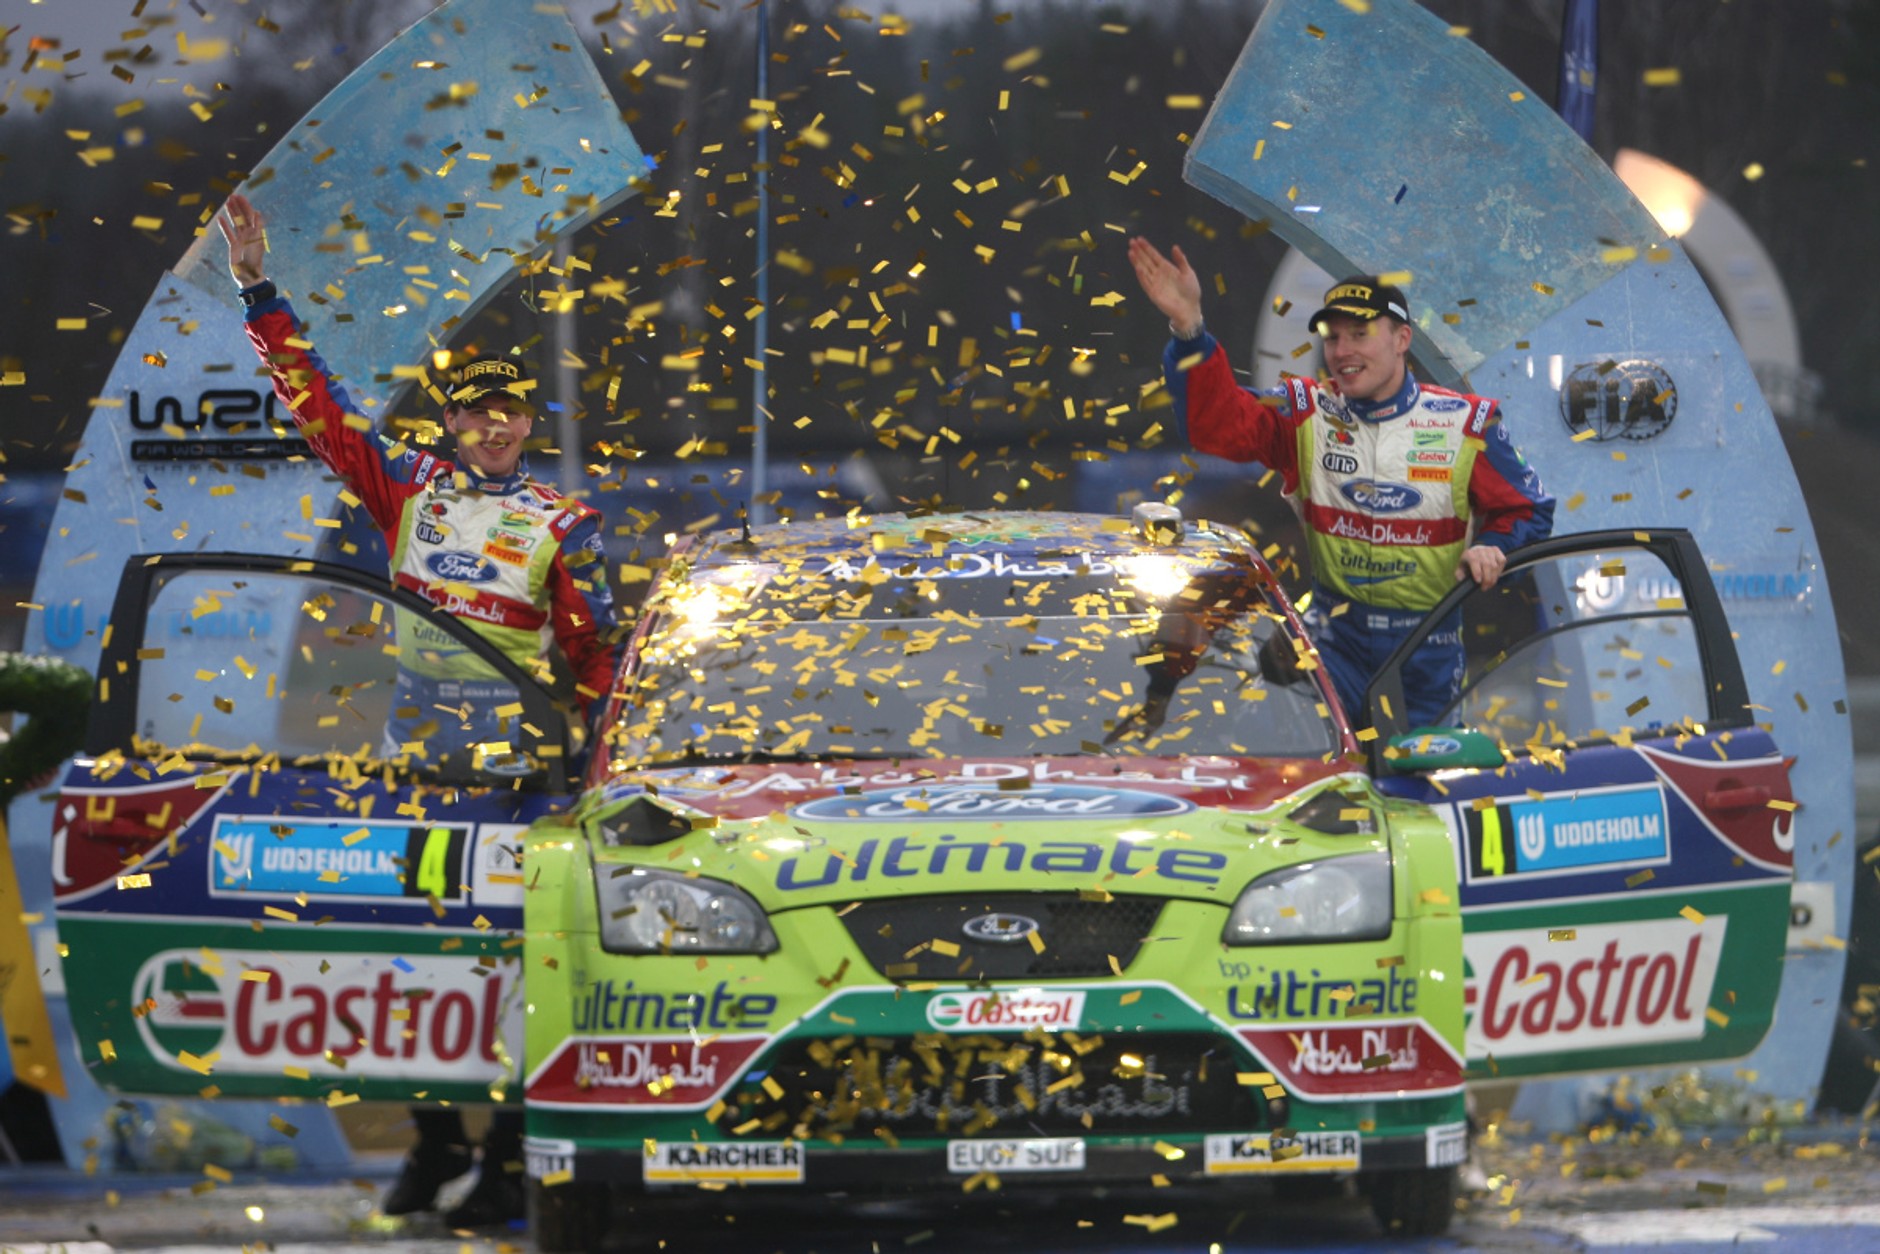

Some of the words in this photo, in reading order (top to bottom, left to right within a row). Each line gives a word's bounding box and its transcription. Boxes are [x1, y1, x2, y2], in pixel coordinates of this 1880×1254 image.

[463, 360, 518, 382] PIRELLI
[1353, 485, 1406, 509] Ford
[1328, 515, 1371, 541] Abu
[1371, 523, 1432, 545] Dhabi
[437, 555, 486, 579] Ford
[946, 550, 1124, 578] Dhab
[1340, 555, 1417, 574] ultimate
[448, 593, 505, 624] Dhabi
[719, 768, 914, 798] Abu
[944, 760, 1252, 791] Dhabi
[864, 786, 1120, 817] Ford
[1481, 803, 1505, 877] 4
[1553, 813, 1660, 848] UDDEHOLM
[262, 846, 399, 875] UDDEHOLM
[416, 828, 451, 898] 4
[776, 834, 1229, 891] ultimate
[1219, 958, 1250, 980] bp
[1481, 933, 1703, 1040] Castrol
[573, 979, 778, 1031] ultimate
[1228, 966, 1417, 1019] ultimate
[233, 965, 504, 1064] Castrol
[620, 1042, 719, 1086] Dhabi
[1288, 1030, 1361, 1074] Abu
